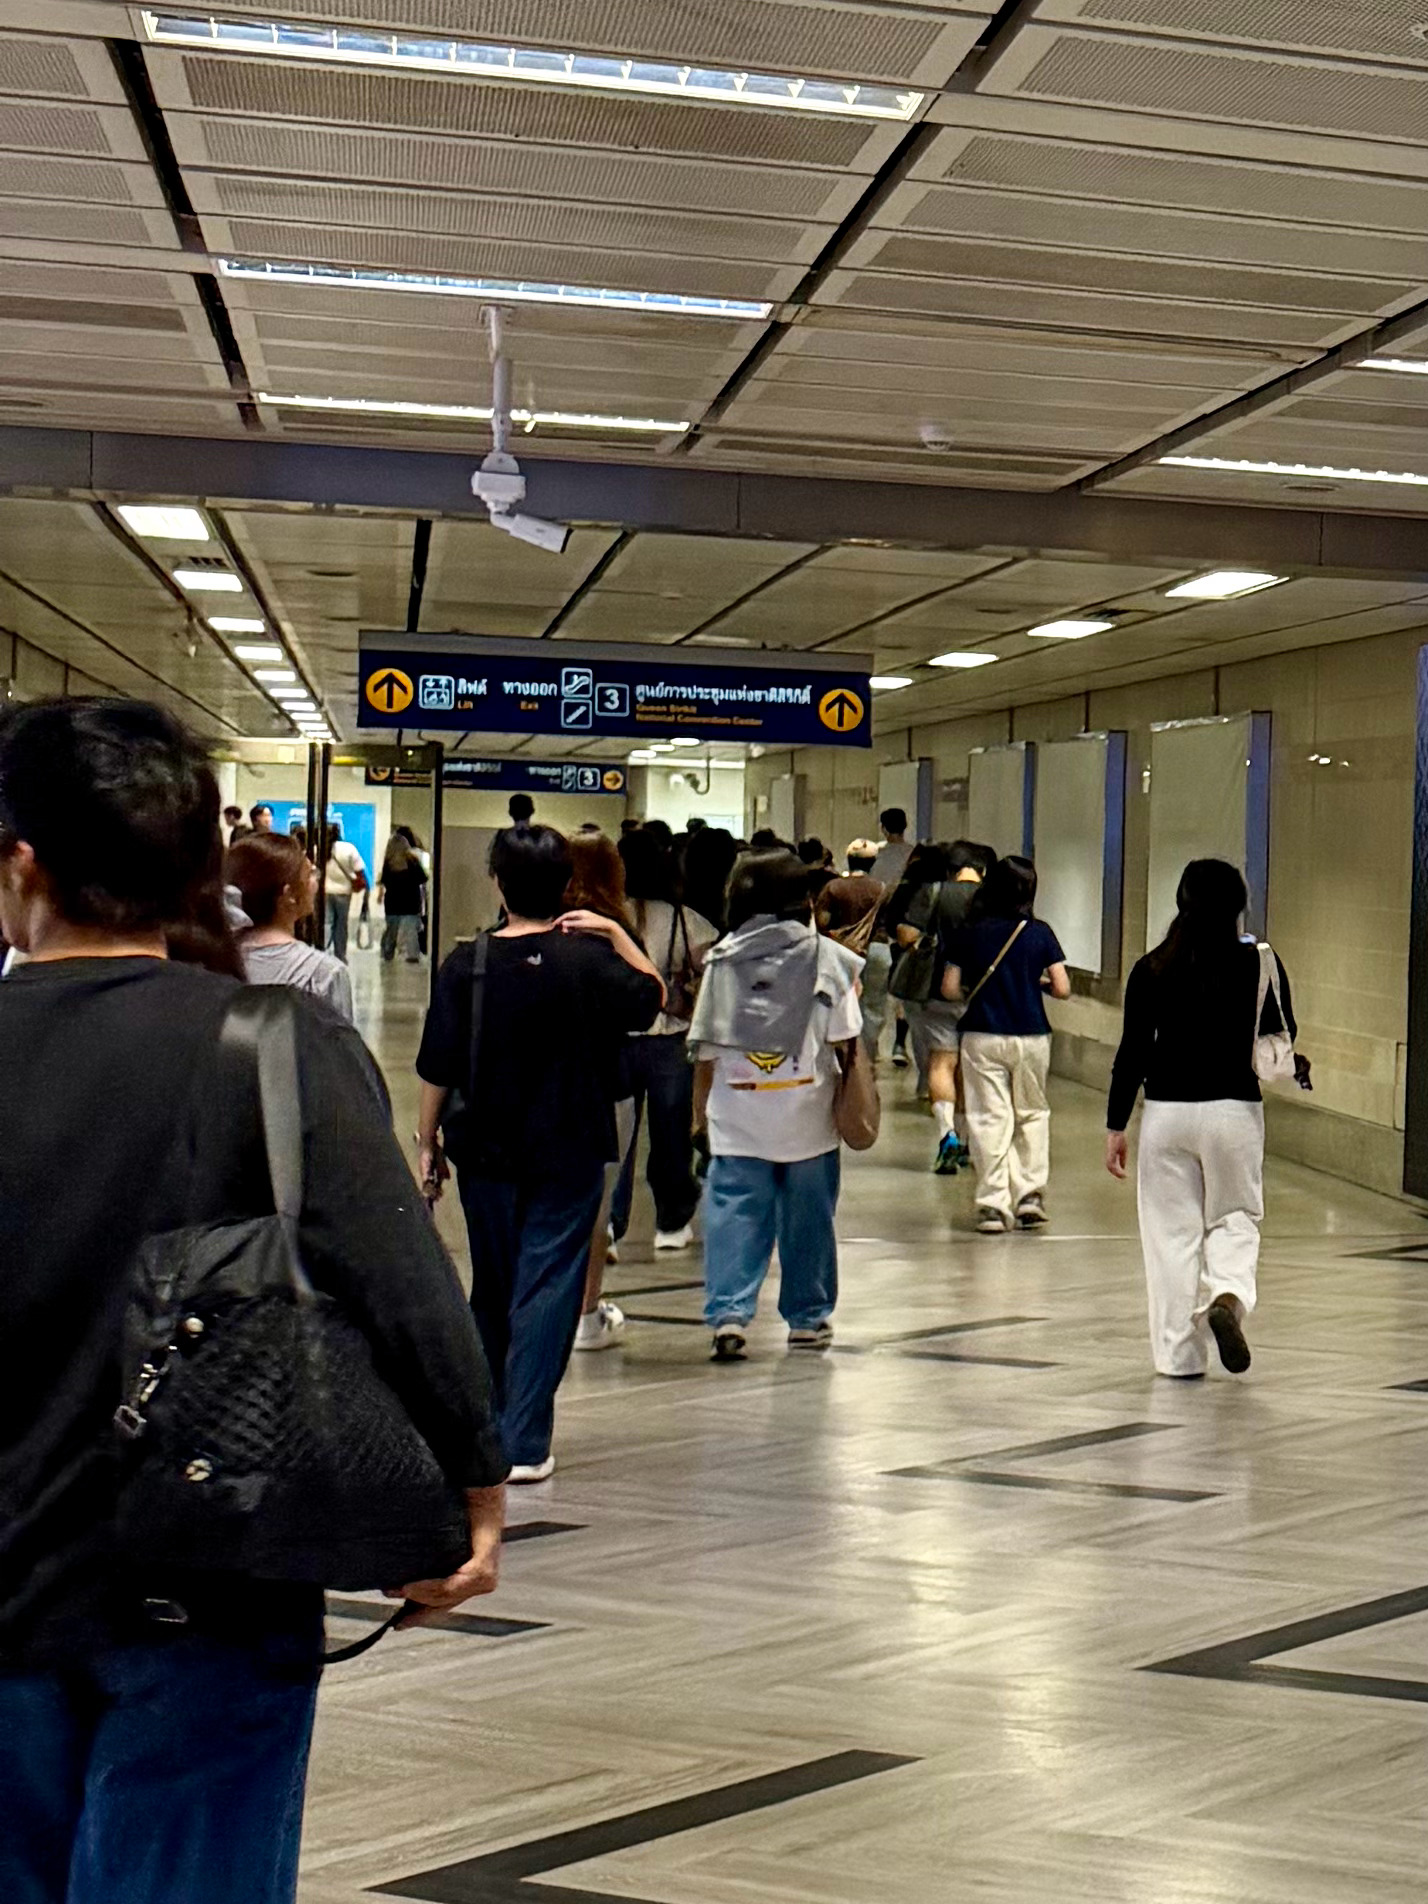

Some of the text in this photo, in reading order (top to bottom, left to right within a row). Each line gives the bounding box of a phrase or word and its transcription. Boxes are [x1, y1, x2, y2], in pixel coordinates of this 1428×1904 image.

[502, 680, 558, 696] ทางออก
[604, 689, 620, 710] 3
